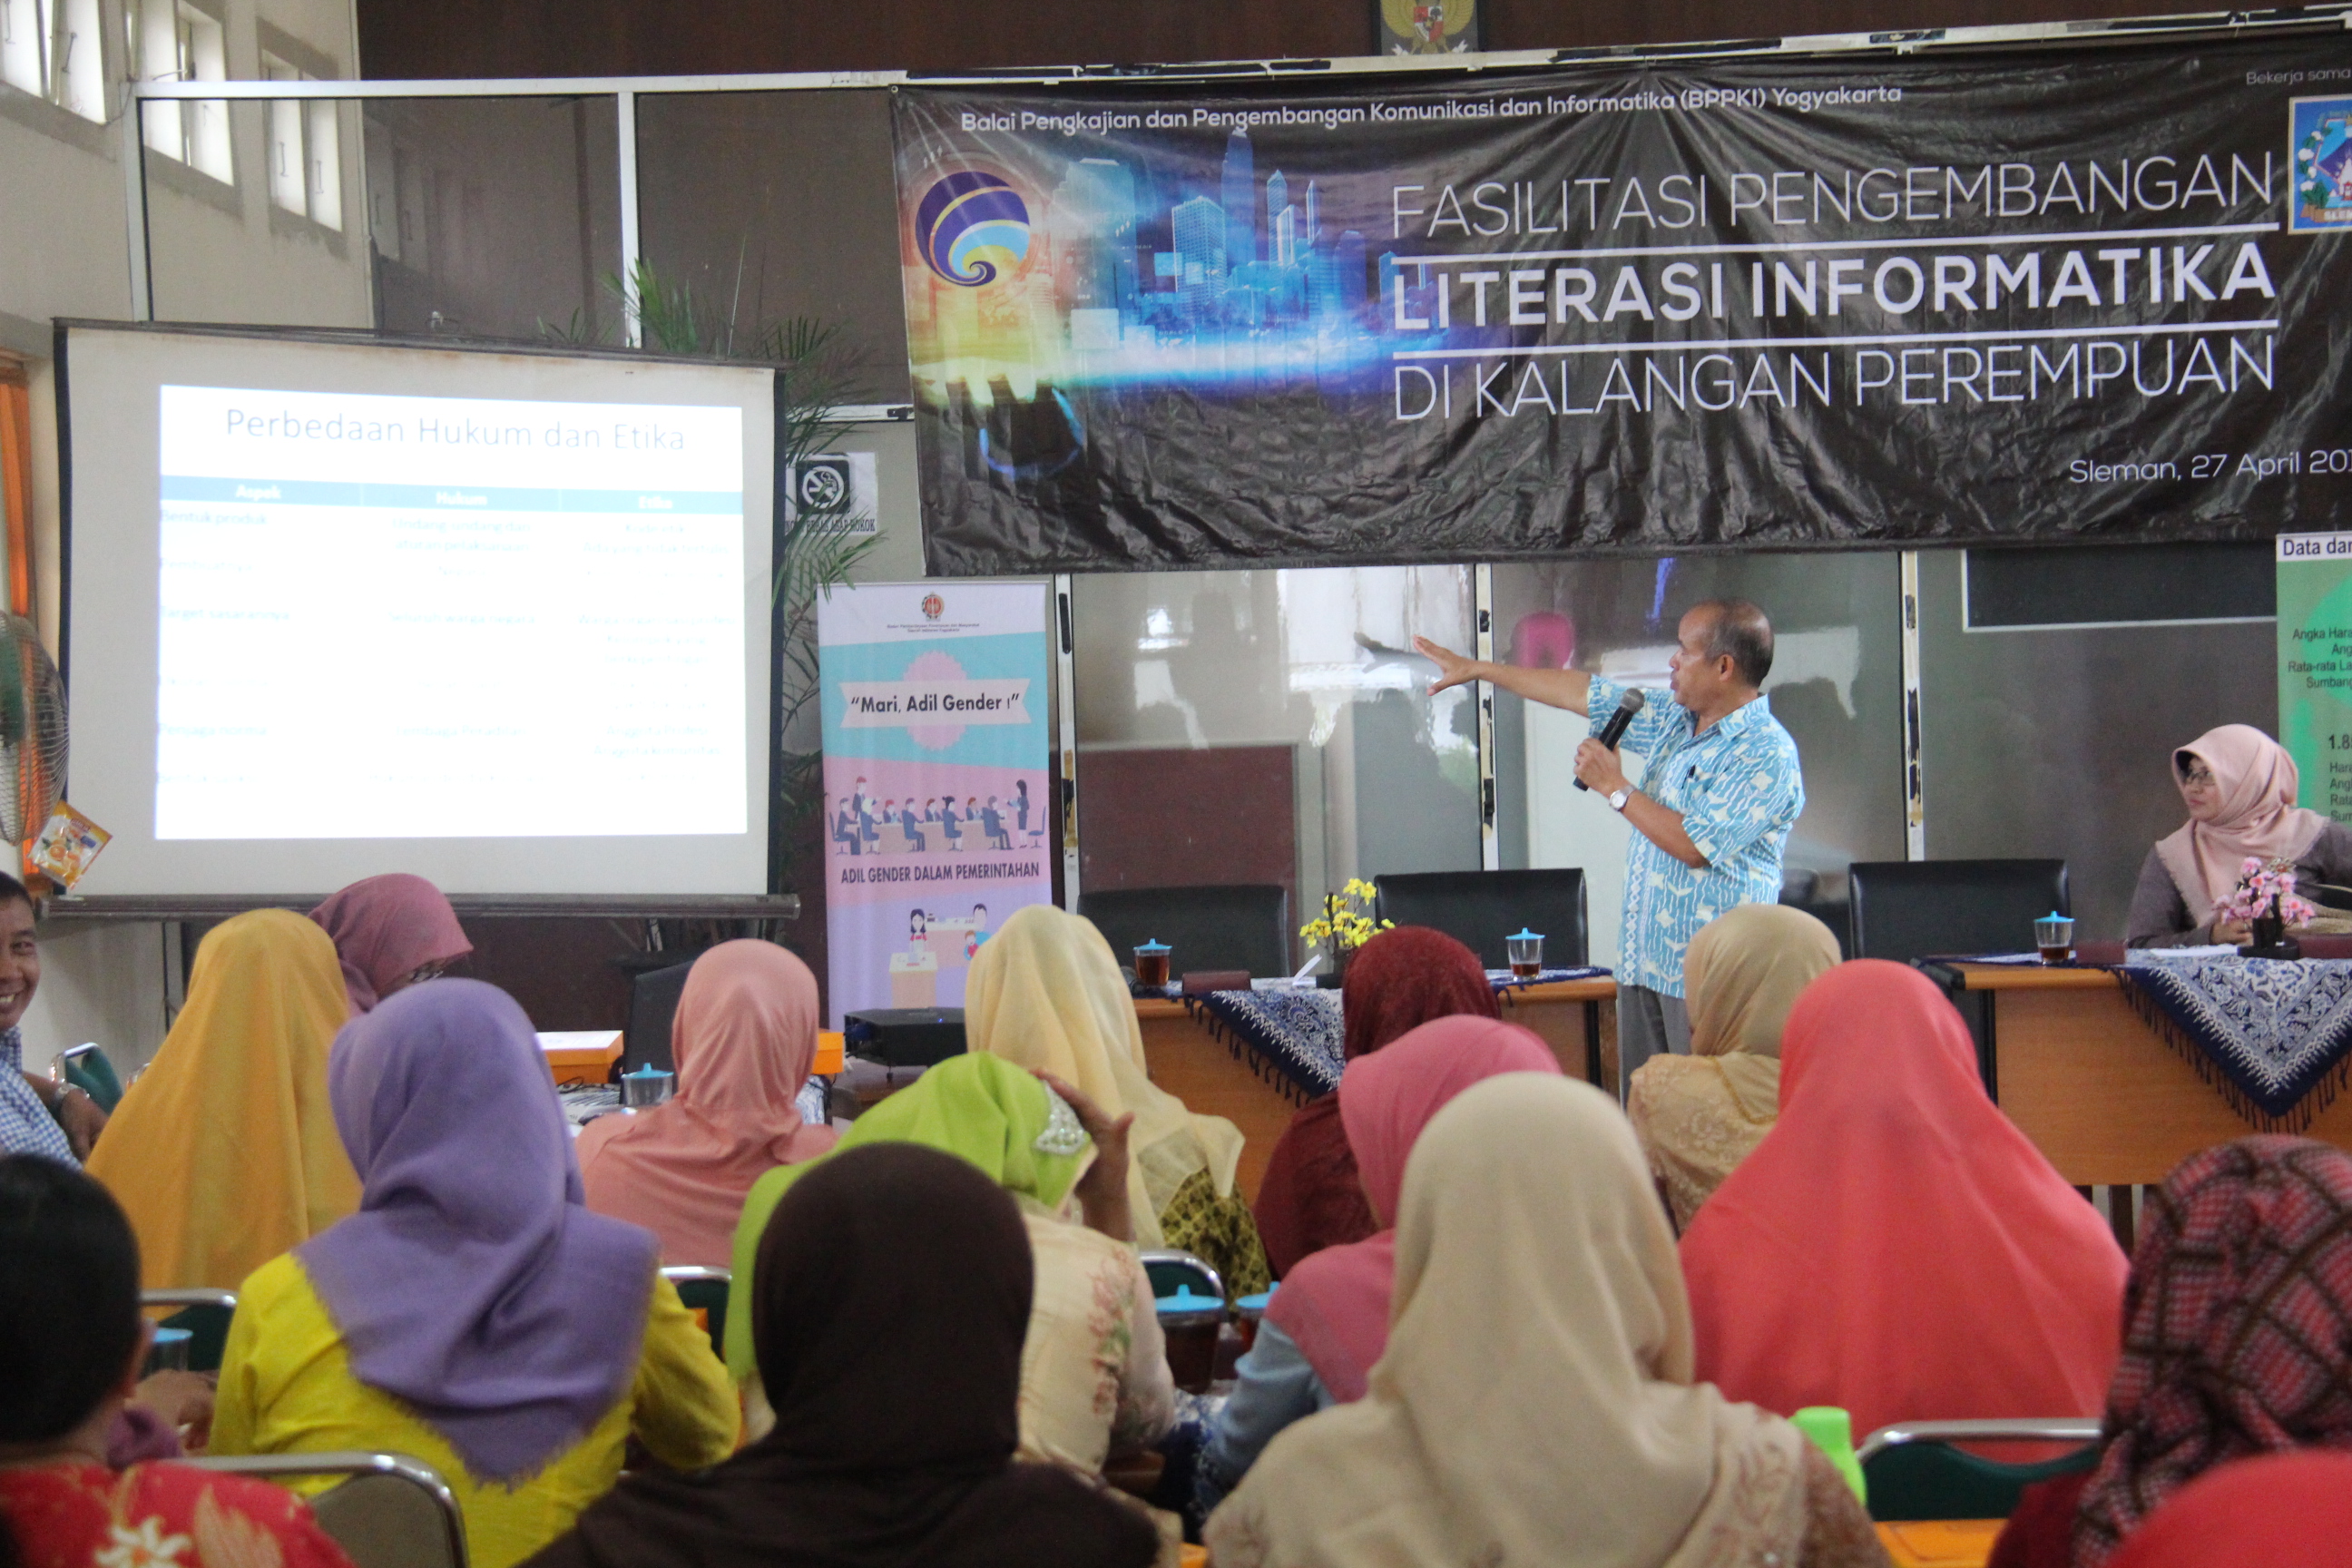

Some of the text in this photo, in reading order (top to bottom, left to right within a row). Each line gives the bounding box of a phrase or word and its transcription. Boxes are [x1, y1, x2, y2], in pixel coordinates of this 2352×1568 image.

[2246, 68, 2351, 85] Bekerja sama
[961, 86, 1901, 136] Balai Pengkajian dan Pengembangan Komunikasi dan Informatika (BPPKI) Yogyakarta
[1394, 151, 2271, 239] FASILITASI PENGEMBANGAN
[1394, 242, 2276, 330] LITERASI INFORMATIKA
[1395, 335, 2273, 421] DI KALANGAN PEREMPUAN
[226, 407, 685, 452] Perbedaan Hukum dan Etika
[2069, 459, 2182, 484] Sleman,
[2191, 455, 2228, 478] 27
[2236, 451, 2300, 480] April
[236, 485, 281, 501] Aspek
[436, 492, 487, 505] Hukum
[2283, 539, 2320, 555] Data
[2292, 628, 2325, 642] Angka
[2288, 661, 2336, 672] Rata-rata
[906, 694, 937, 711] Adil
[944, 693, 1002, 710] Gender
[2328, 733, 2352, 750] 1.8
[2329, 778, 2352, 792] Ang
[841, 862, 1040, 884] ADIL GENDER DALAM PEMERINTAHAN
